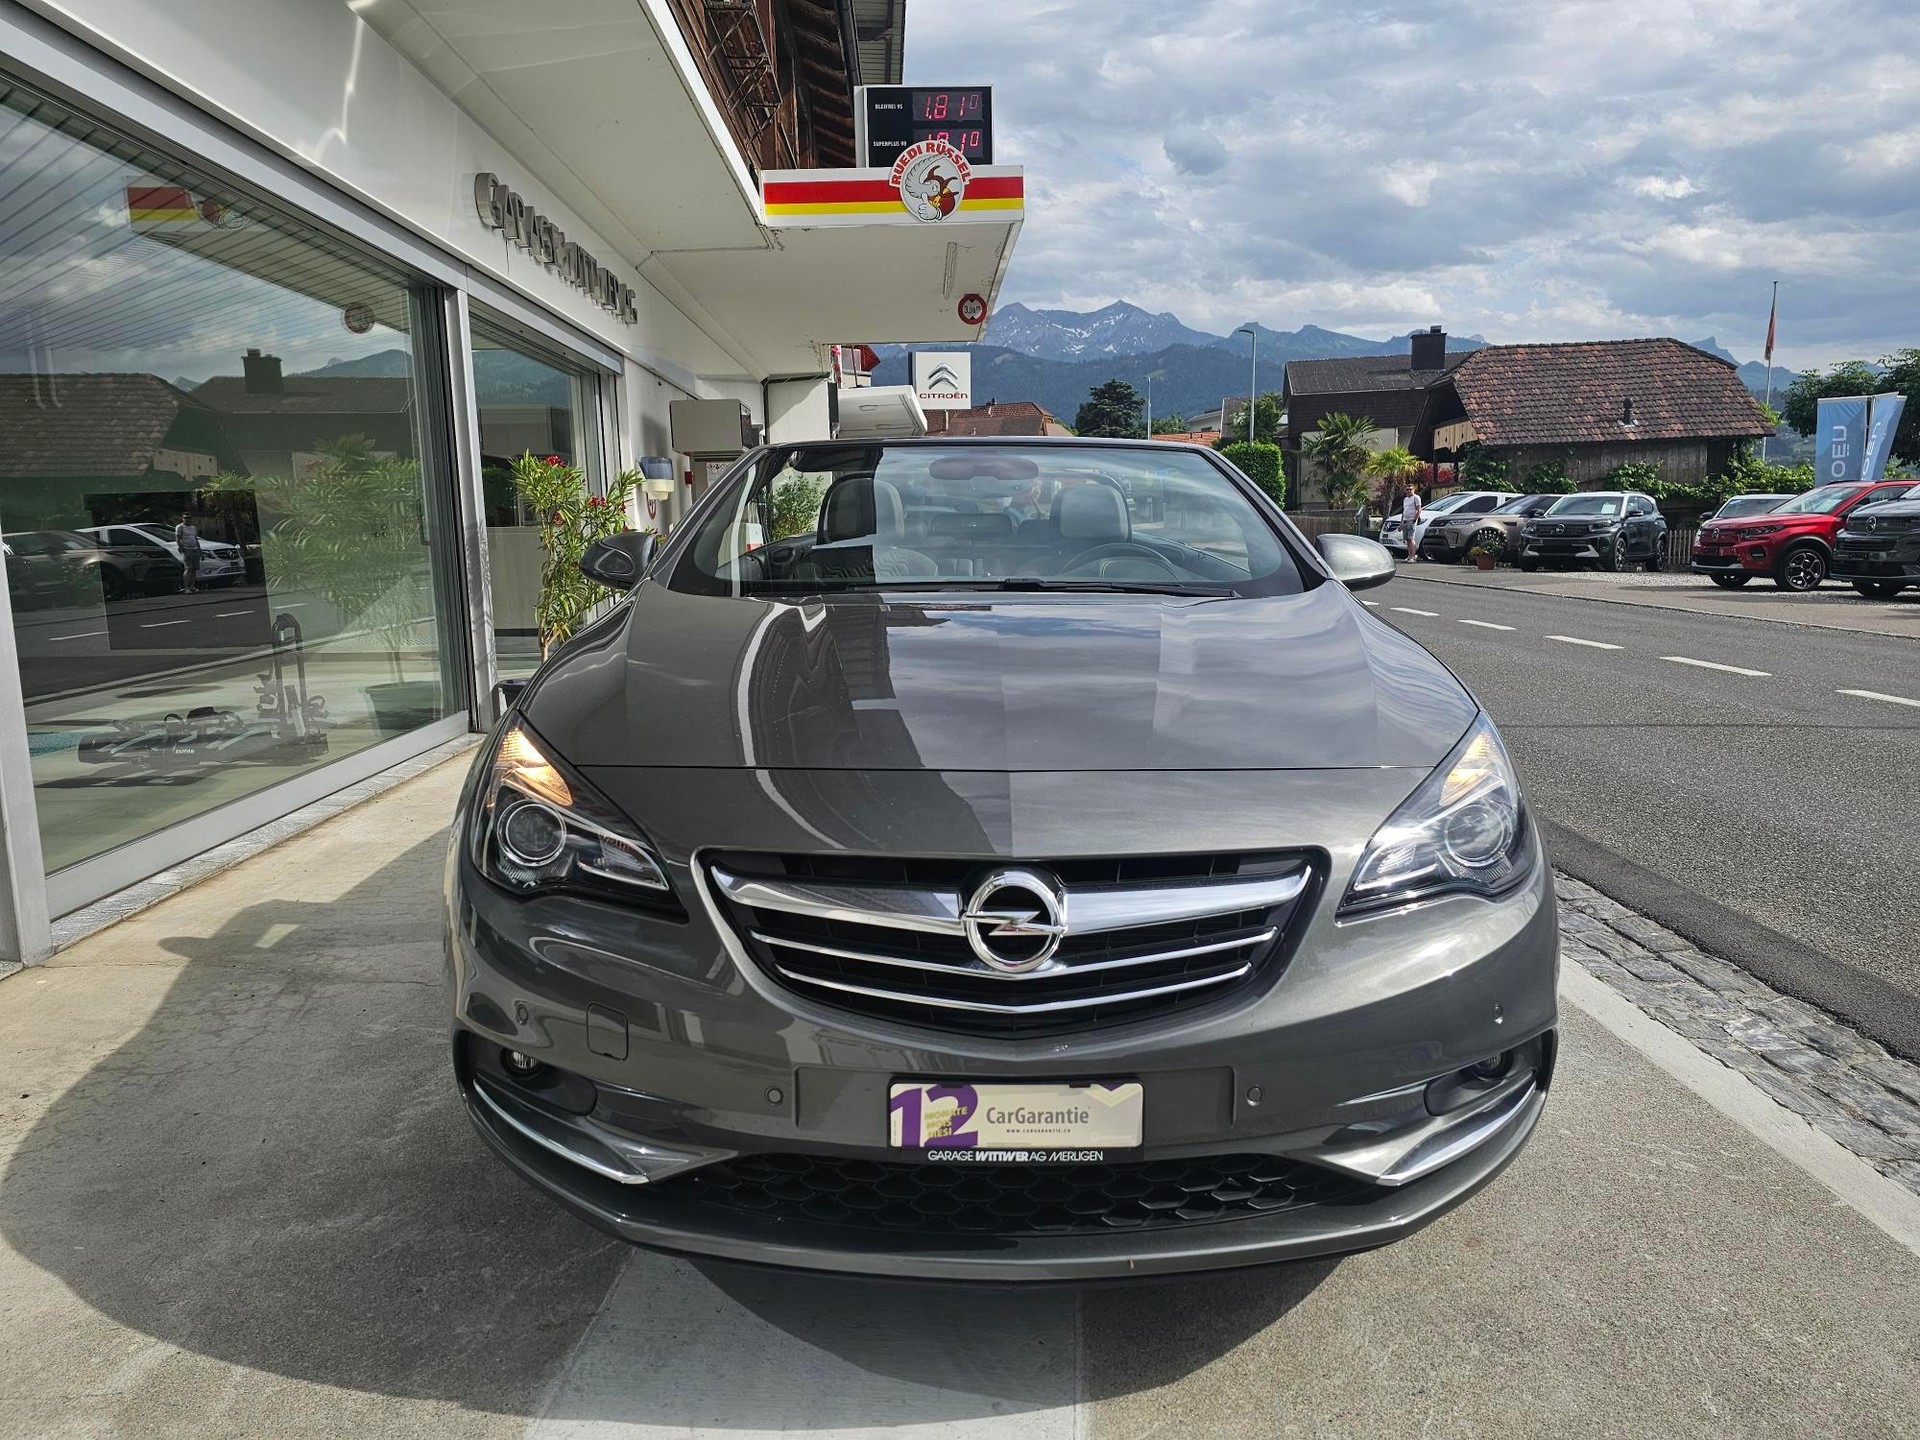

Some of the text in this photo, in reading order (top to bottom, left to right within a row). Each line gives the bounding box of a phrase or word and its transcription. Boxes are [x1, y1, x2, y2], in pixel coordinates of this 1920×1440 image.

[890, 139, 972, 186] RUEDI RÜSSEL
[890, 1084, 979, 1147] 12
[986, 1106, 1090, 1124] CarGarantie
[928, 1150, 975, 1161] GARAGE
[975, 1150, 1029, 1161] WITTWER
[1029, 1150, 1047, 1161] AG
